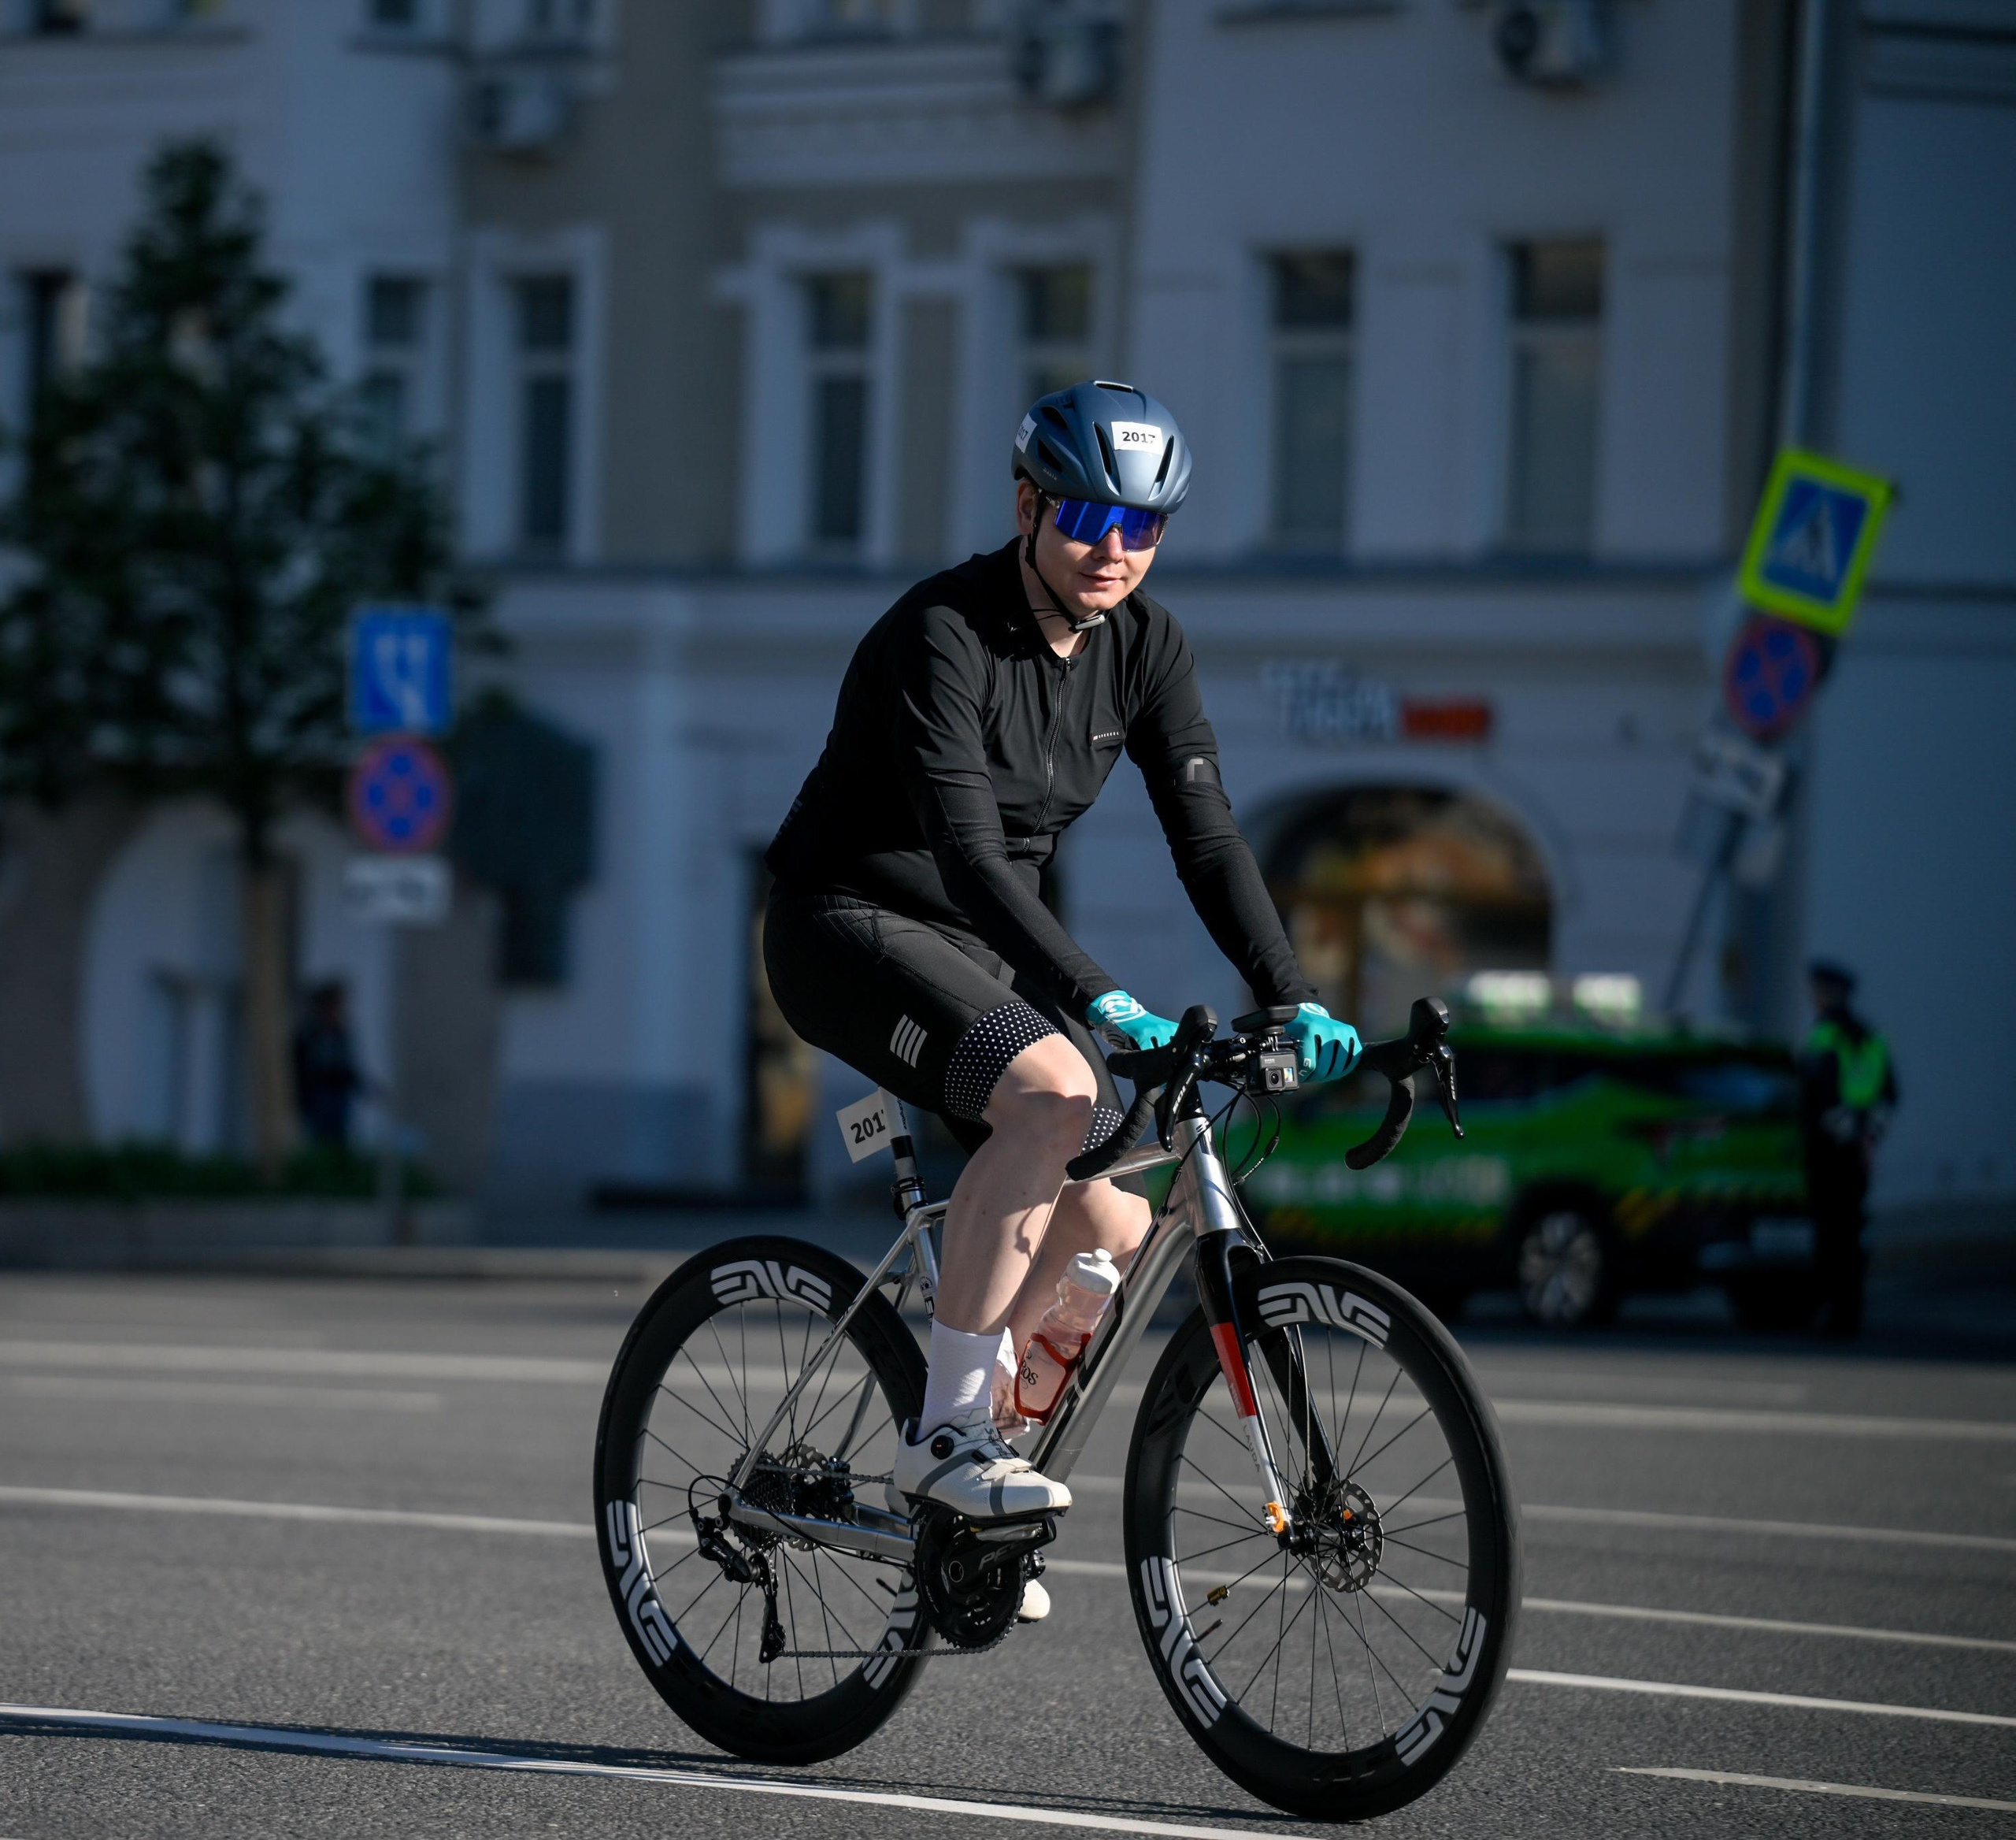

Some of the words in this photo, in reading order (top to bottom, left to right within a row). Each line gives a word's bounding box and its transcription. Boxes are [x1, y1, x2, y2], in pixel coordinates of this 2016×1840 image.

[1121, 431, 1155, 443] 2017
[850, 1109, 886, 1144] 201
[1243, 1424, 1260, 1472] LAUDA
